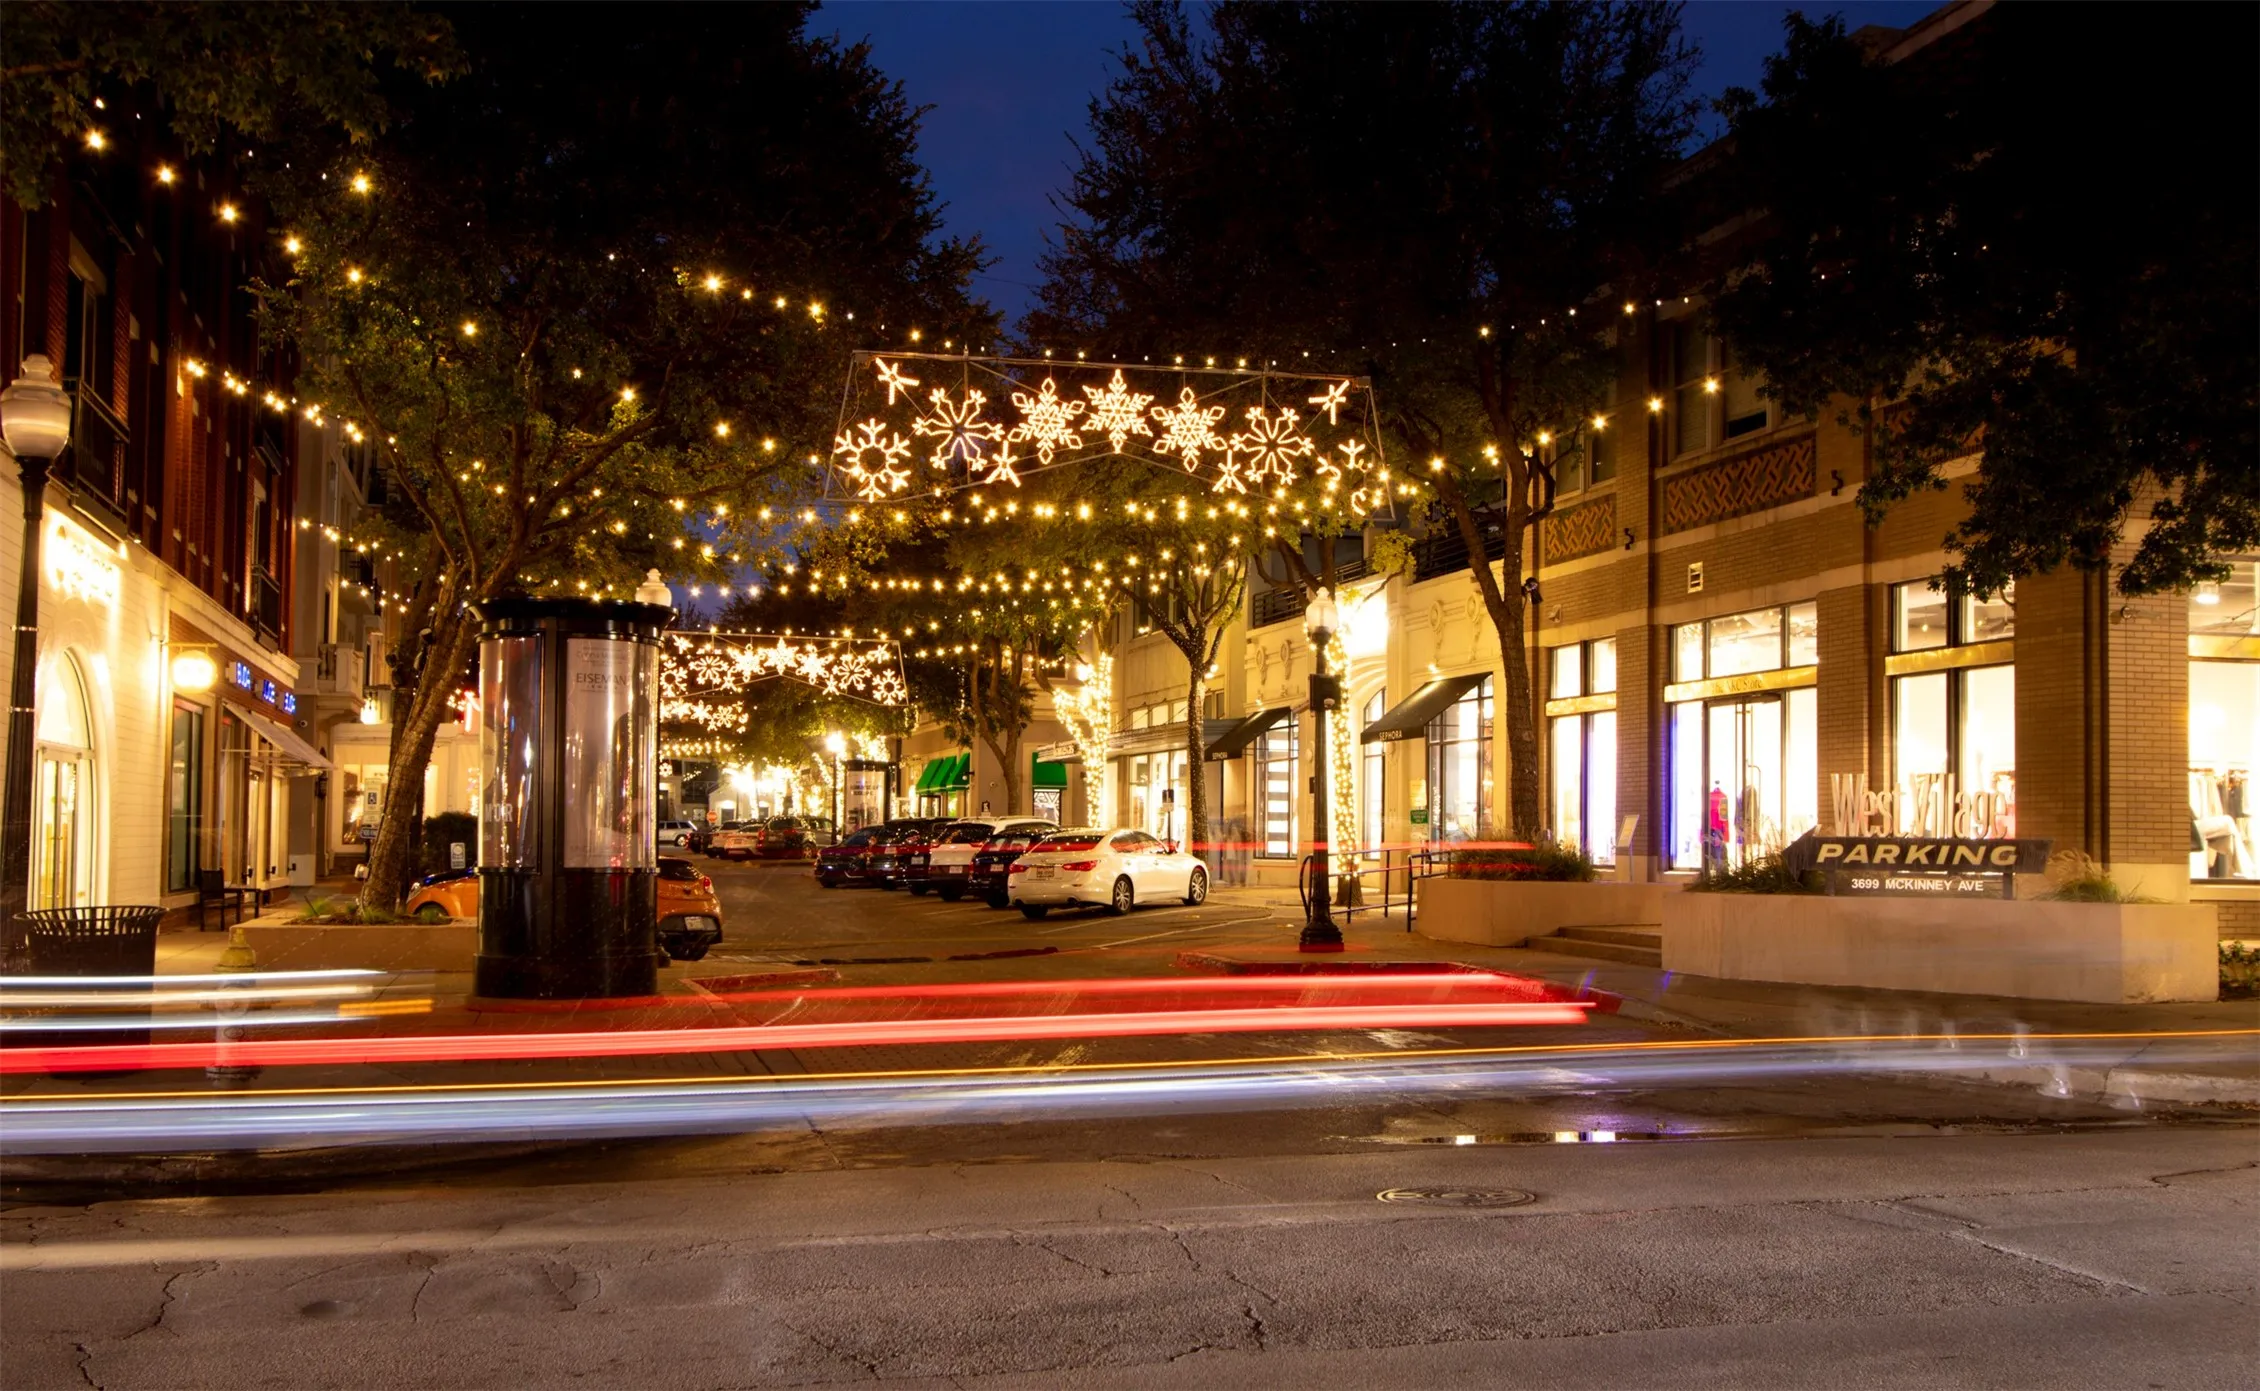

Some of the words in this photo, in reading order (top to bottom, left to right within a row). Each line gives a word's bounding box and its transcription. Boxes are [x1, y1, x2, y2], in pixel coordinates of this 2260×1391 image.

[1379, 730, 1402, 741] SEPHORA
[1831, 773, 1908, 838] West
[1910, 773, 2008, 839] Village
[1816, 844, 2018, 866] PARKING
[1851, 878, 1880, 889] 3699
[1885, 879, 1952, 891] MCKINNEY
[1957, 880, 1984, 891] AVE
